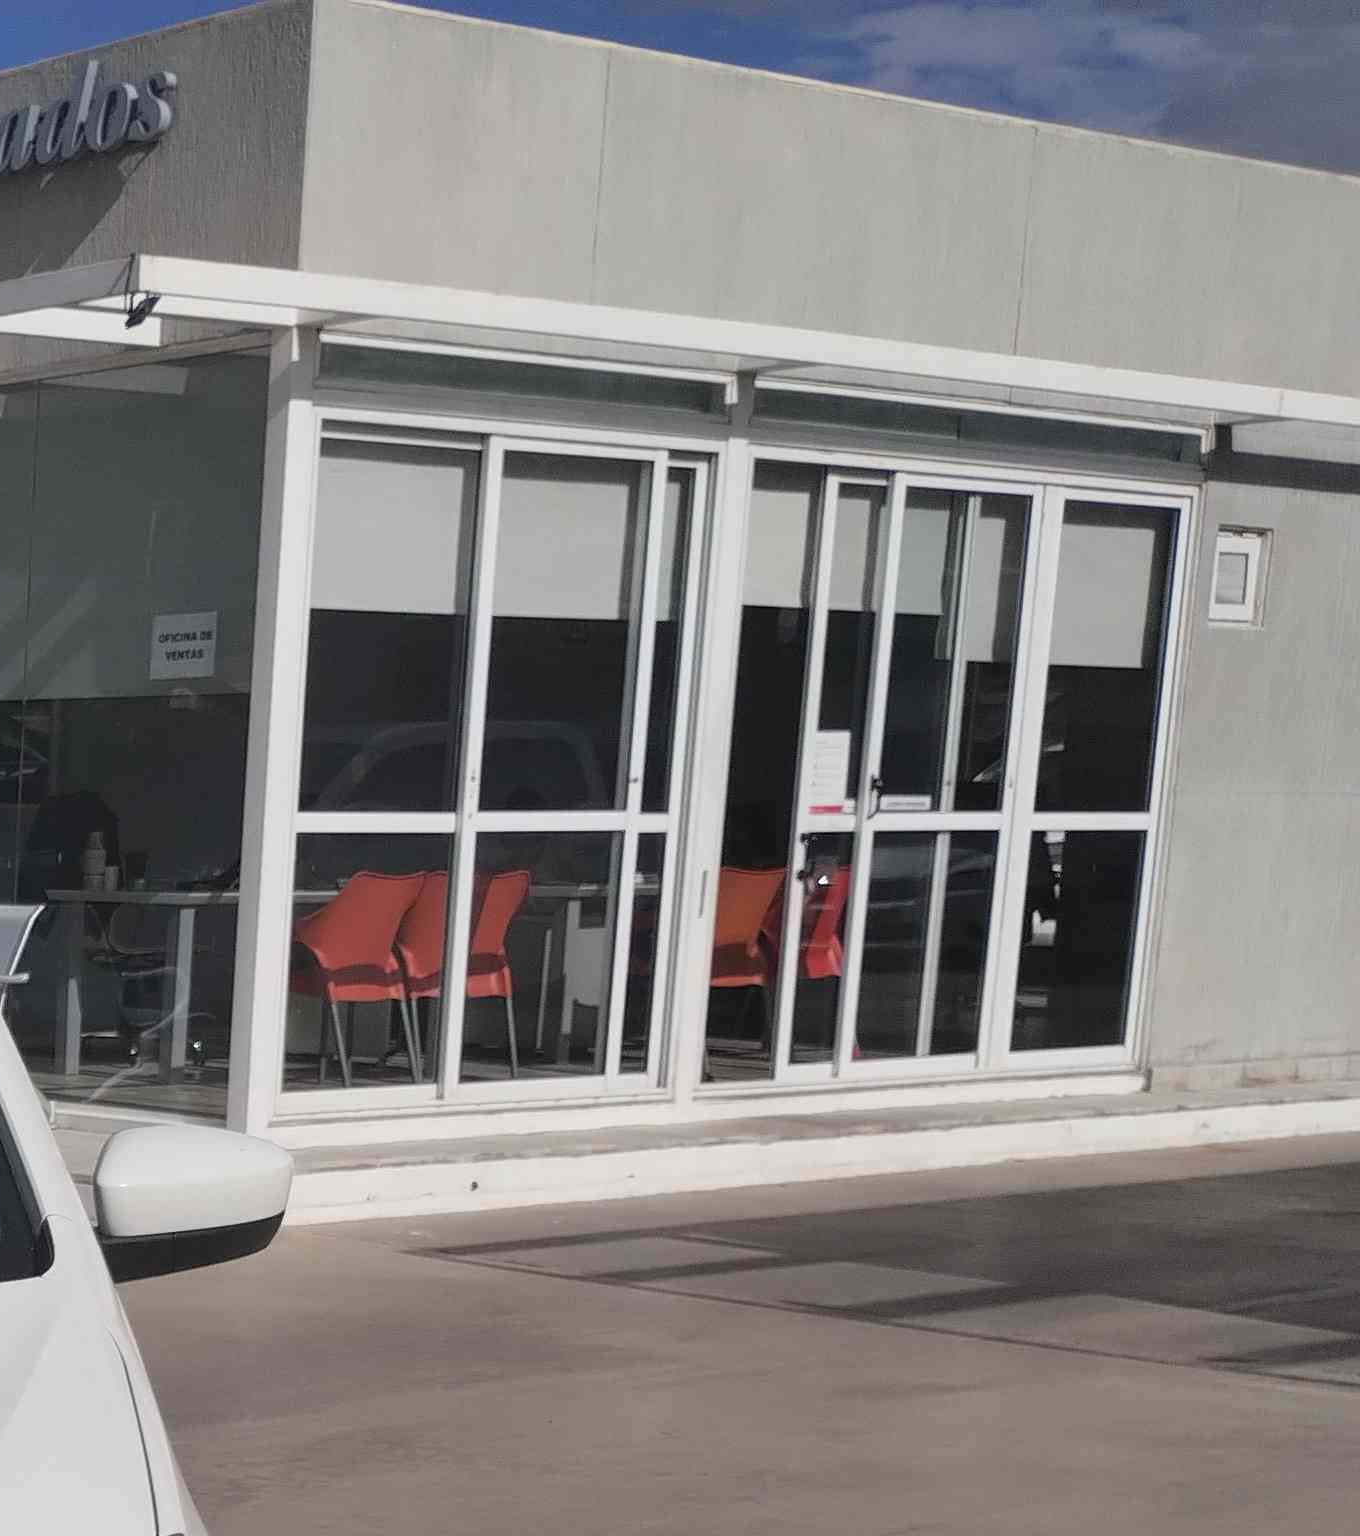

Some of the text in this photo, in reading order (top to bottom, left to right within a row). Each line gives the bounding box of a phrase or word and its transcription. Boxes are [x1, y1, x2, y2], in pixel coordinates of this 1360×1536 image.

[159, 631, 212, 643] OFICINA DE
[165, 649, 203, 661] VENTAS
